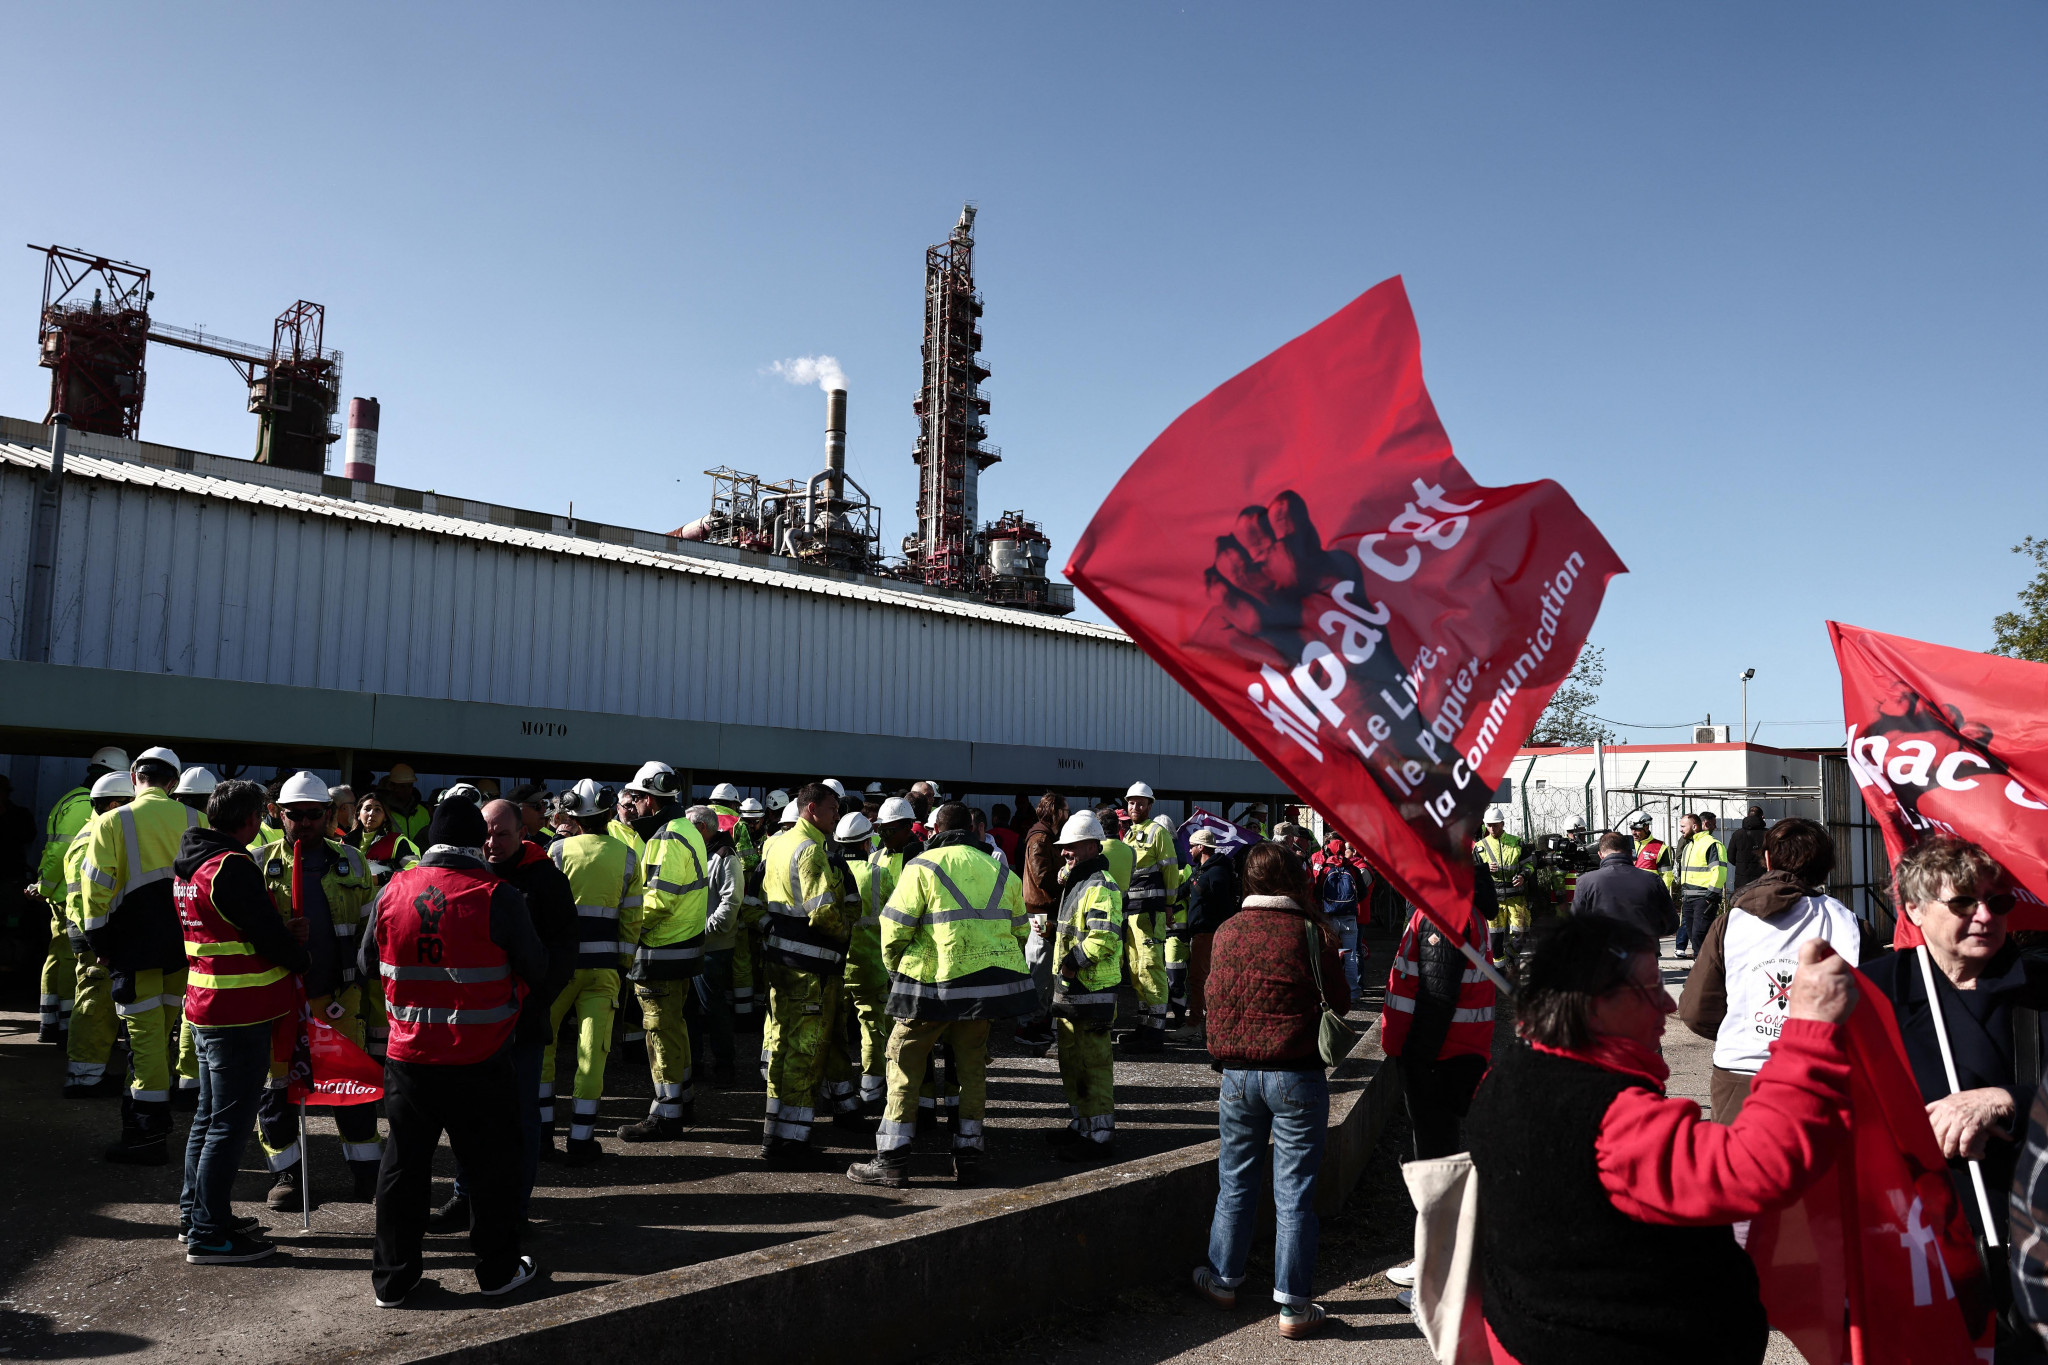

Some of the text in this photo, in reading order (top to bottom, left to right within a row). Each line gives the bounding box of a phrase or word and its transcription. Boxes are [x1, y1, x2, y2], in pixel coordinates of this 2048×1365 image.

[1358, 477, 1484, 582] cgt
[1424, 550, 1586, 828] la Communication
[520, 720, 568, 737] MOTO
[1347, 714, 1391, 759] Le
[1057, 758, 1084, 770] MOTO
[1847, 724, 1991, 795] lpac
[1385, 760, 1425, 796] le
[418, 937, 443, 964] FO
[1751, 958, 1799, 973] MEETING INTERN
[1754, 1011, 1790, 1026] CONT
[1755, 1025, 1780, 1038] GUE
[313, 1080, 377, 1095] nication
